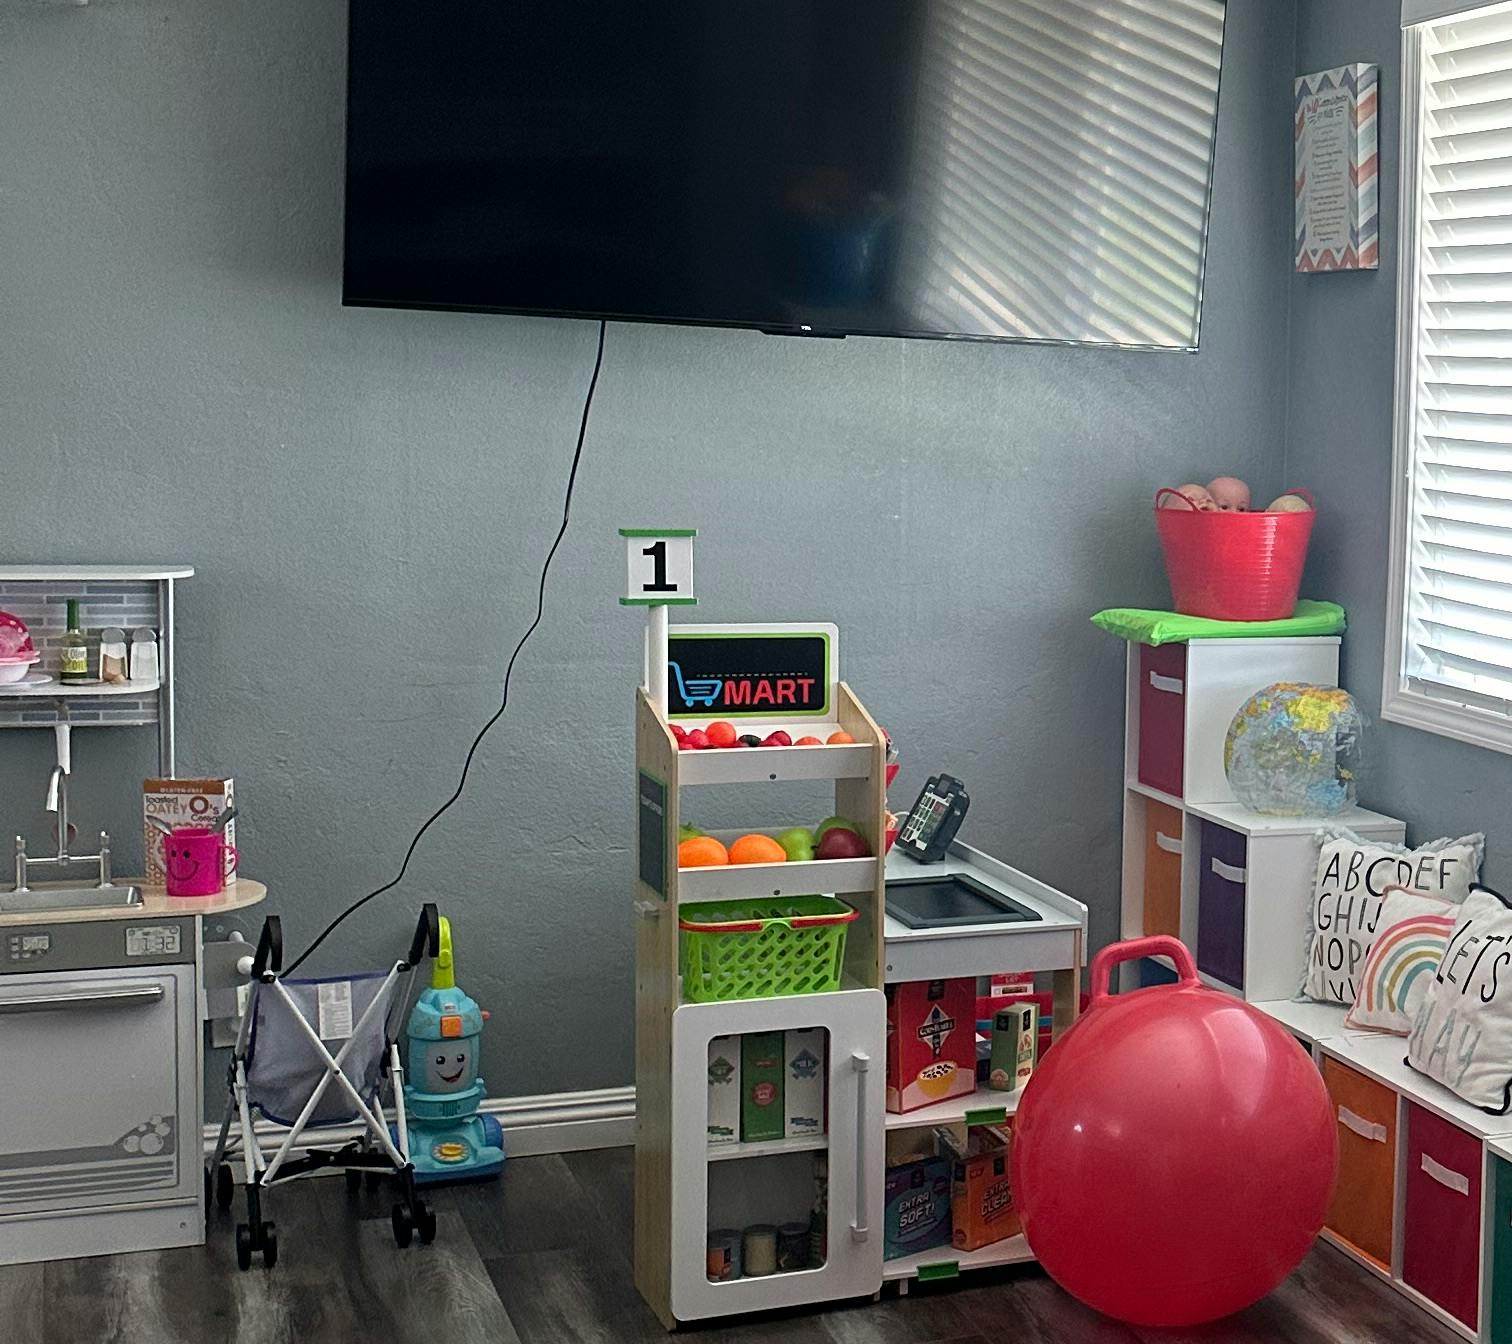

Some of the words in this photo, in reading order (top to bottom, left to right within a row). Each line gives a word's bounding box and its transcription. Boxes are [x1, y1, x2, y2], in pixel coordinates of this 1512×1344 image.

[642, 541, 678, 592] 1
[724, 678, 816, 706] MART
[146, 803, 188, 815] OATEY
[190, 813, 218, 823] Cerea
[1312, 934, 1371, 975] NOP
